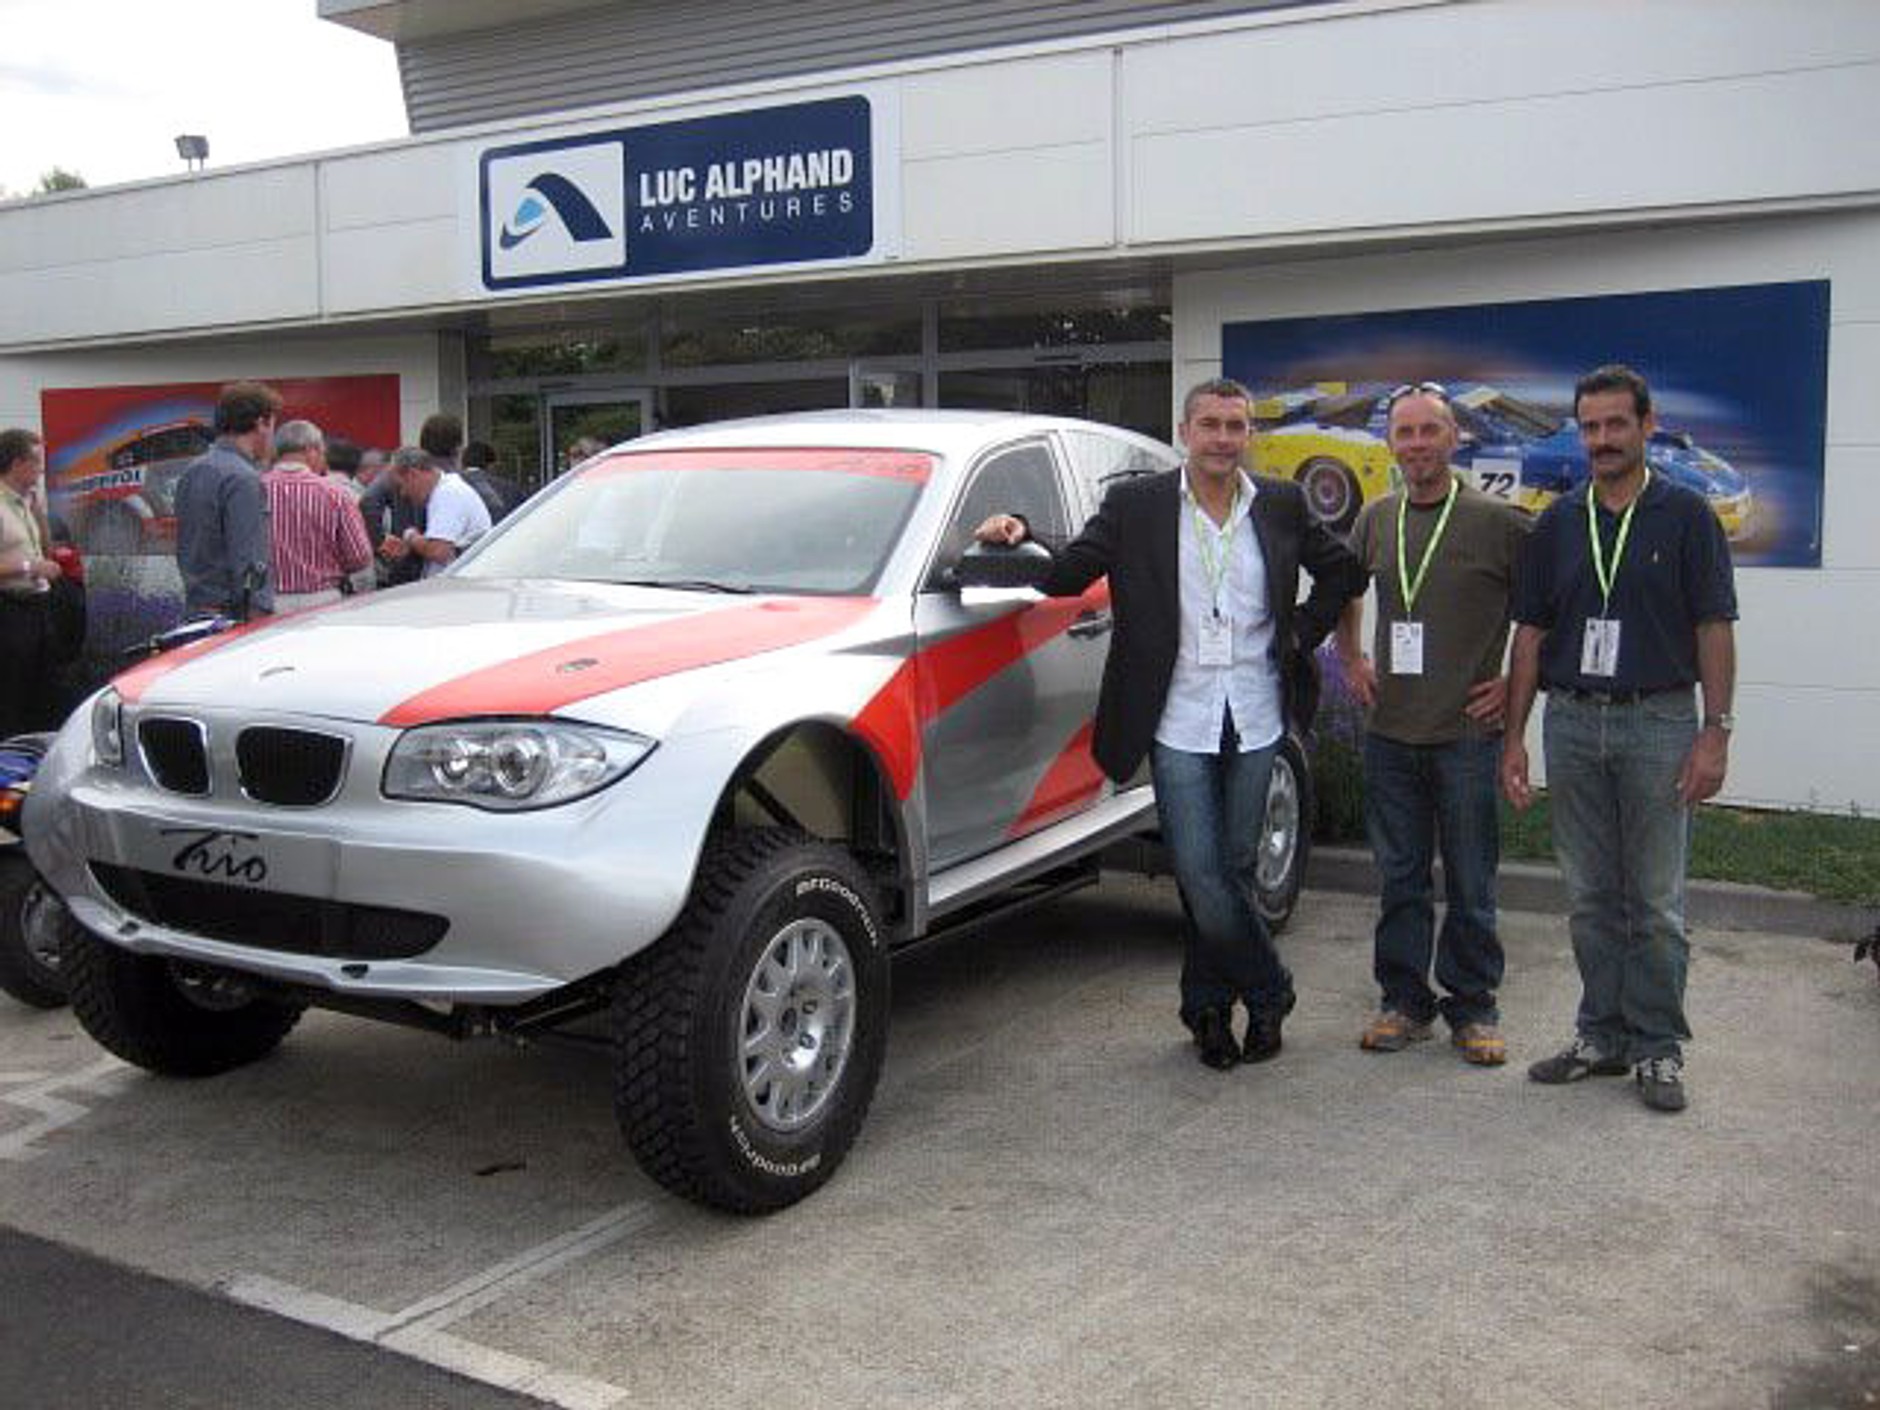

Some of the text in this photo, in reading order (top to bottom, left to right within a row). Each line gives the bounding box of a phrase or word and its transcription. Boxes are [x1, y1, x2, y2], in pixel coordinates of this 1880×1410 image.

[640, 149, 854, 208] LUC ALPHAND
[640, 191, 853, 233] AVENTURES
[1480, 472, 1516, 499] 72
